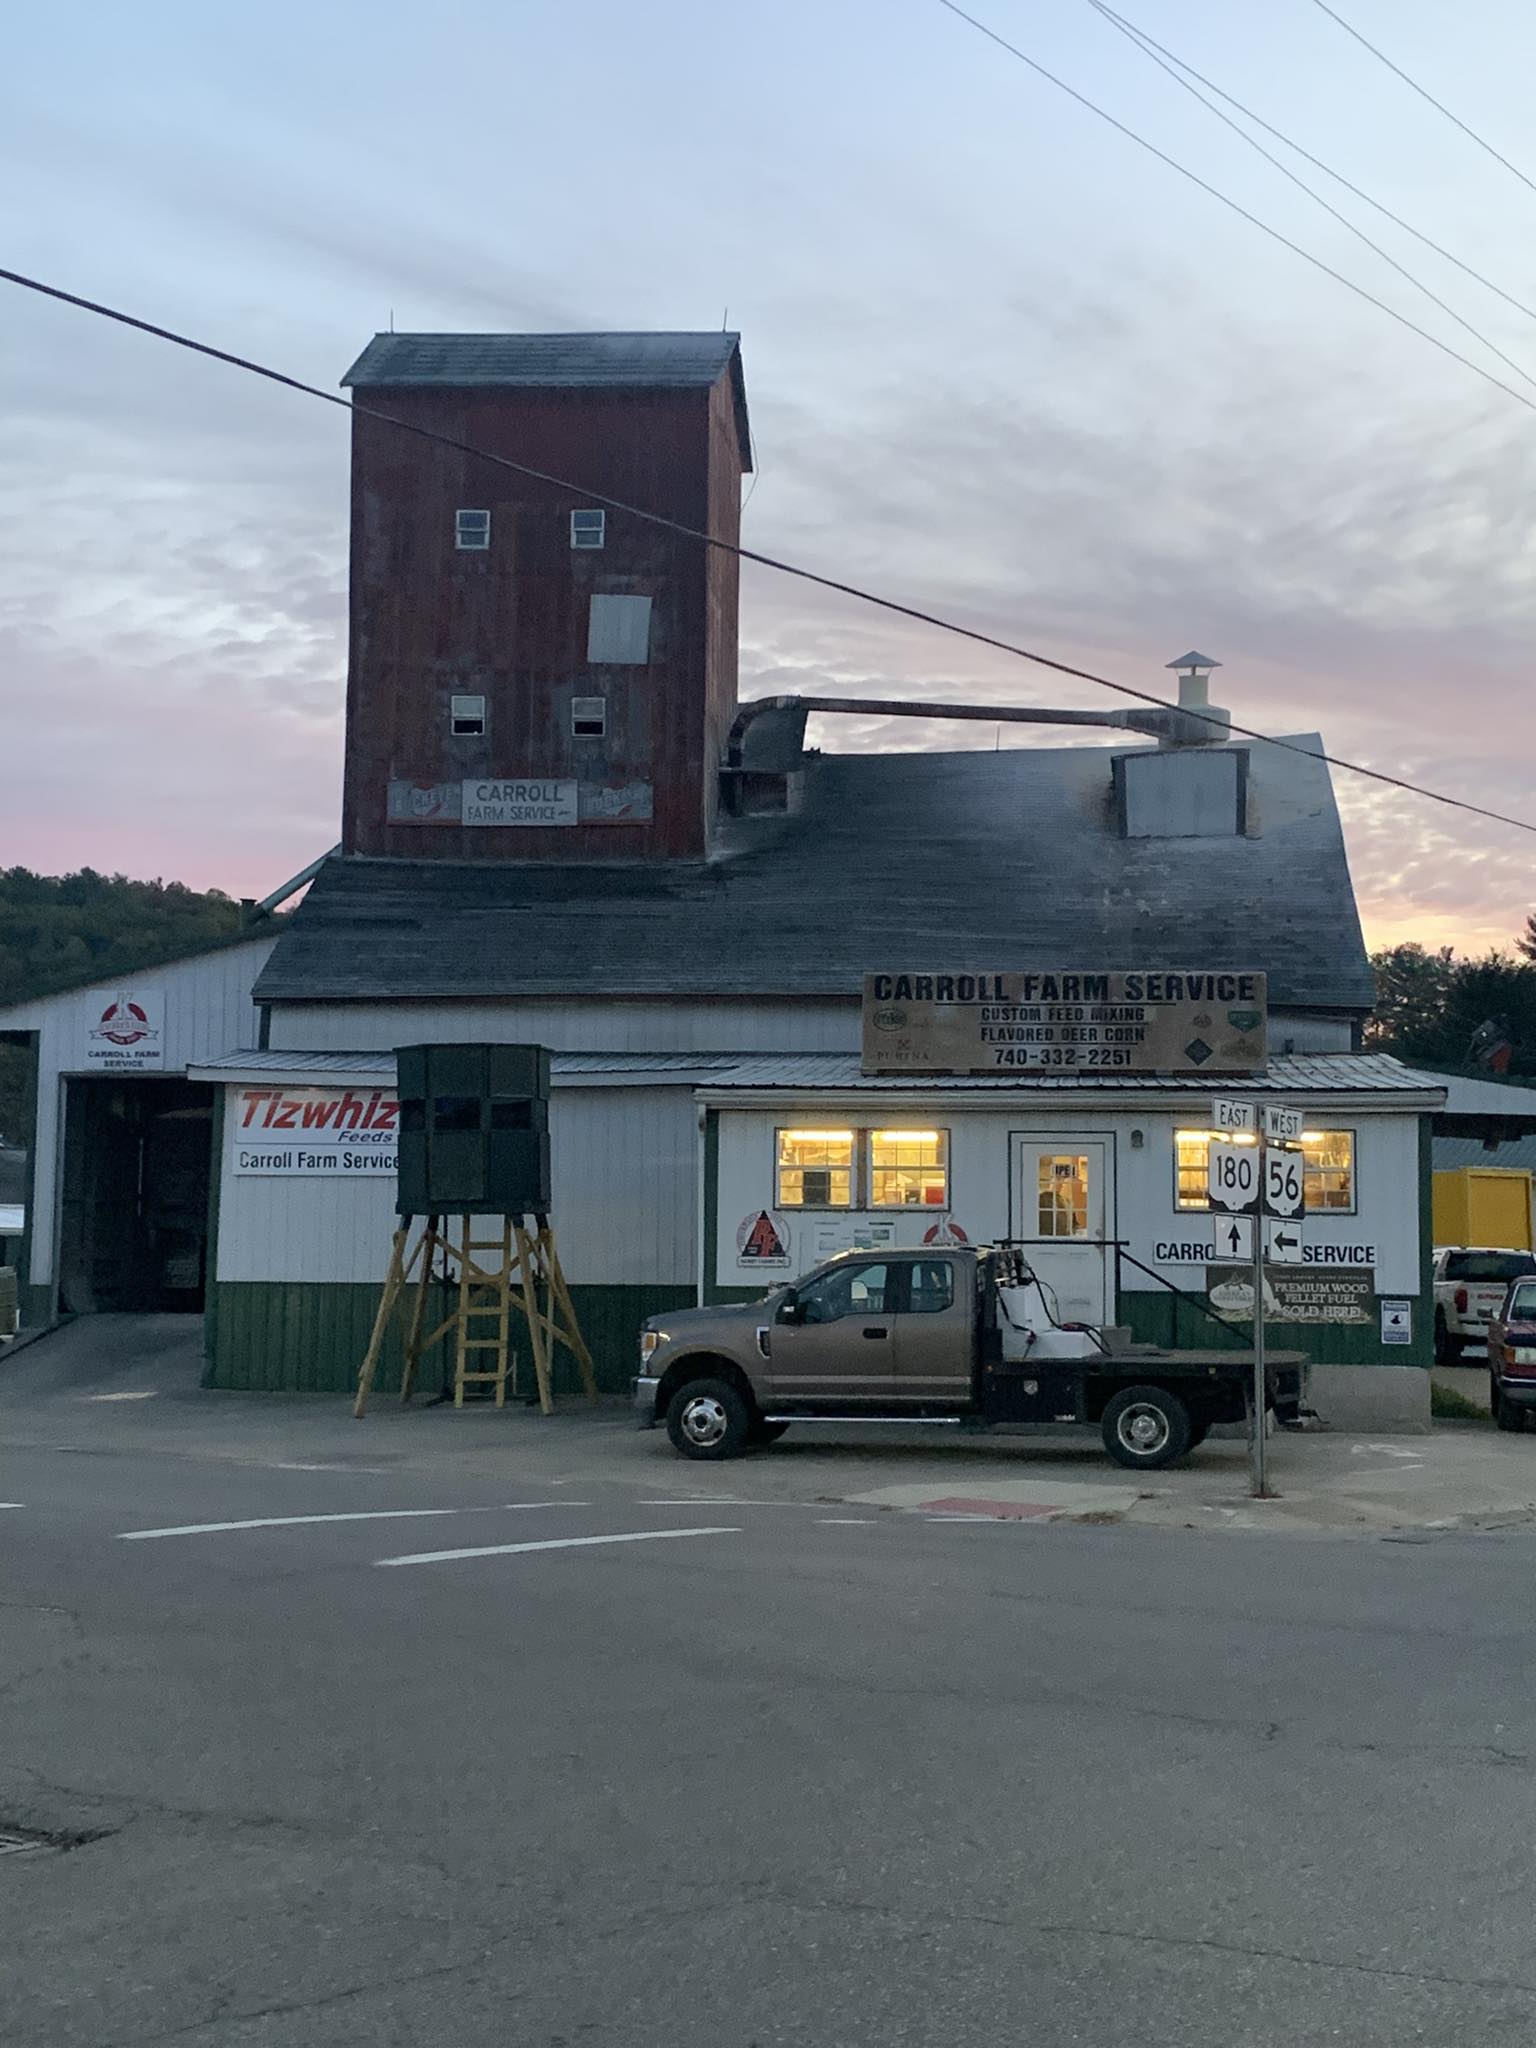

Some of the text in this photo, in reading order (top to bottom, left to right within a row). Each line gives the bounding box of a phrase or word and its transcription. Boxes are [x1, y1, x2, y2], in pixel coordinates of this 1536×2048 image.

[476, 784, 564, 802] CARROLL
[468, 805, 556, 820] FARM SERVICE
[874, 974, 1254, 1001] CARROLL FARM SERVICE
[981, 1007, 1145, 1021] CUSTOM FEED MIXING
[981, 1027, 1145, 1041] FLAVORED DEER CORN
[88, 1050, 160, 1058] CARROLL FARM
[994, 1048, 1132, 1065] 740-332-2251
[103, 1059, 144, 1068] SERVICE
[241, 1091, 400, 1129] Tizwhiz
[1220, 1103, 1248, 1127] EAST
[1270, 1113, 1299, 1134] WEST
[337, 1130, 393, 1143] Feeds
[240, 1151, 400, 1169] Carroll Farm Service
[1217, 1155, 1251, 1190] 180
[1269, 1161, 1299, 1201] 56
[1156, 1243, 1375, 1263] CARRO SERVICE
[1274, 1282, 1369, 1294] PREMIUM WOOD
[1285, 1293, 1359, 1304] PELLET FUEL
[1282, 1304, 1360, 1318] SOLD HERE
